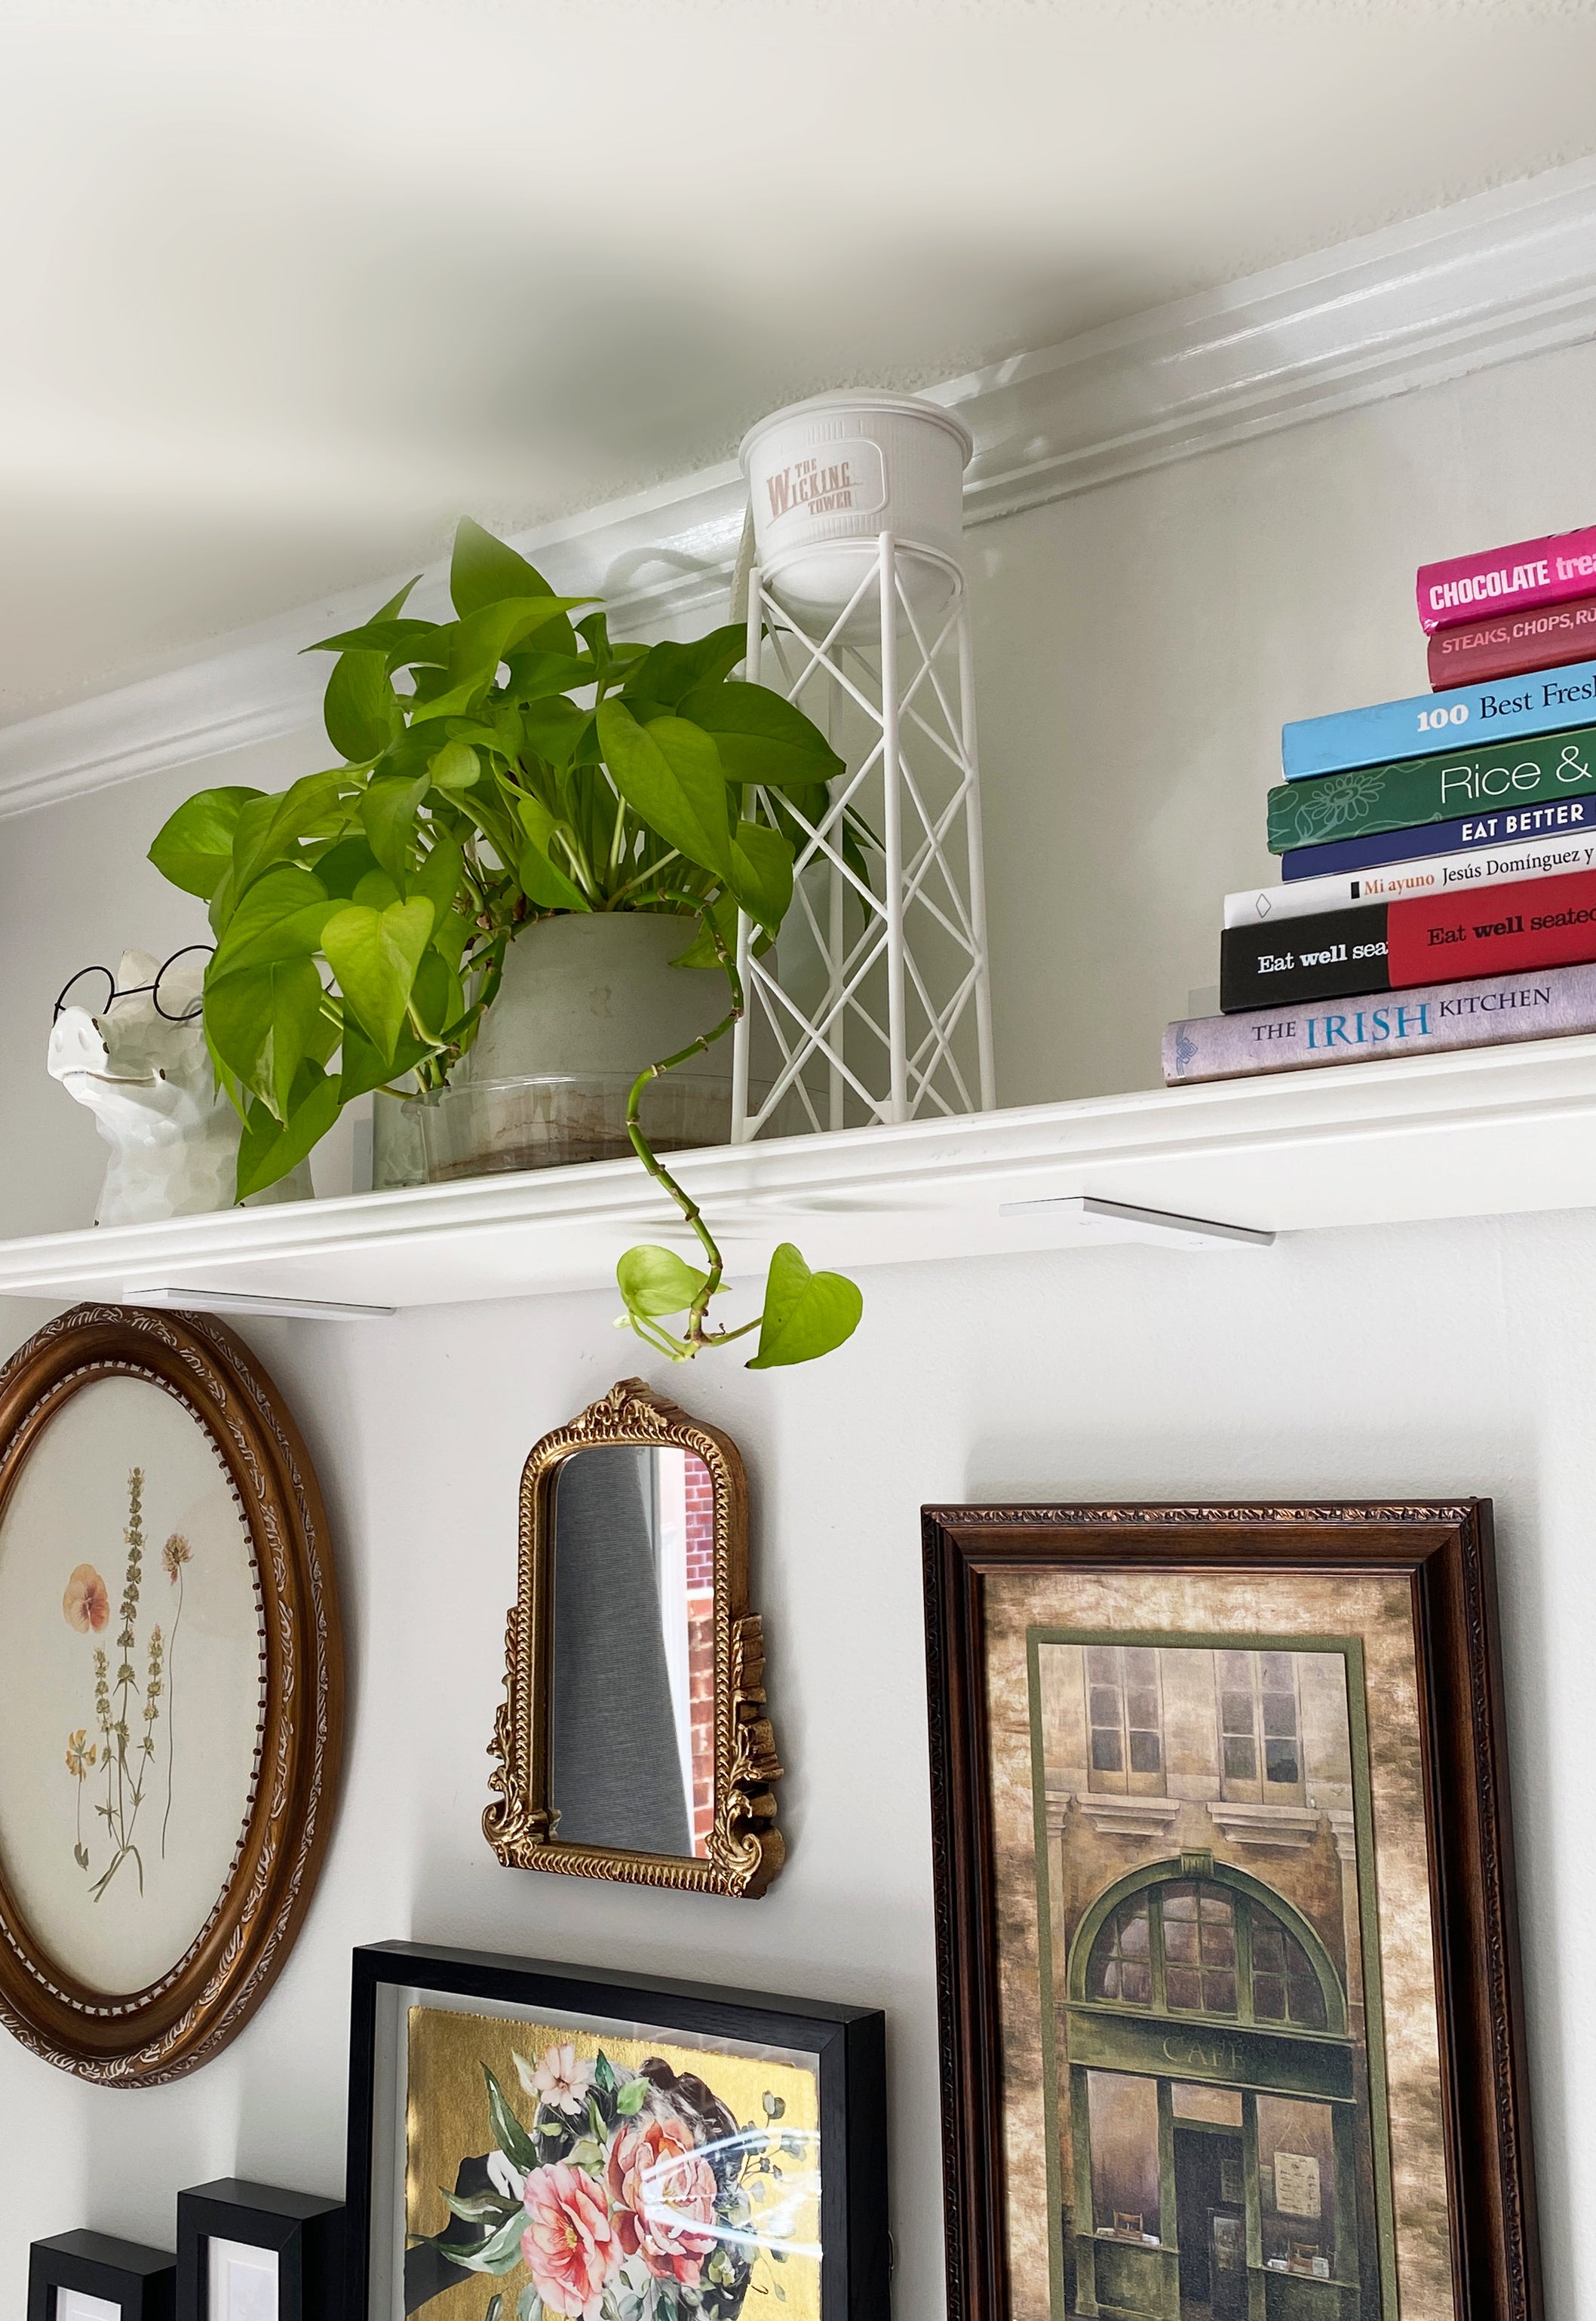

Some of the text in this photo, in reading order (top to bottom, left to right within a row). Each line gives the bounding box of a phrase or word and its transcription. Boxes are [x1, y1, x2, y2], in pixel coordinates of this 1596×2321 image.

[795, 458, 817, 478] THE
[766, 461, 852, 519] WICKING
[808, 490, 852, 515] TOWER
[1429, 553, 1596, 610] CHOCOLATE tre
[1442, 627, 1511, 654] STEAKS,
[1513, 613, 1574, 638] CHOPS,
[1416, 704, 1469, 732] 100
[1479, 692, 1534, 720] Best
[1441, 745, 1593, 804] Rice &
[1461, 803, 1584, 842] EAT BETTER
[1364, 847, 1594, 895] Mi ayuno Jesús Domínguez y
[1427, 927, 1466, 947] Eat
[1473, 915, 1524, 938] well
[1257, 941, 1388, 973] Eat well sea
[1252, 987, 1552, 1050] THE IRISH KITCHEN
